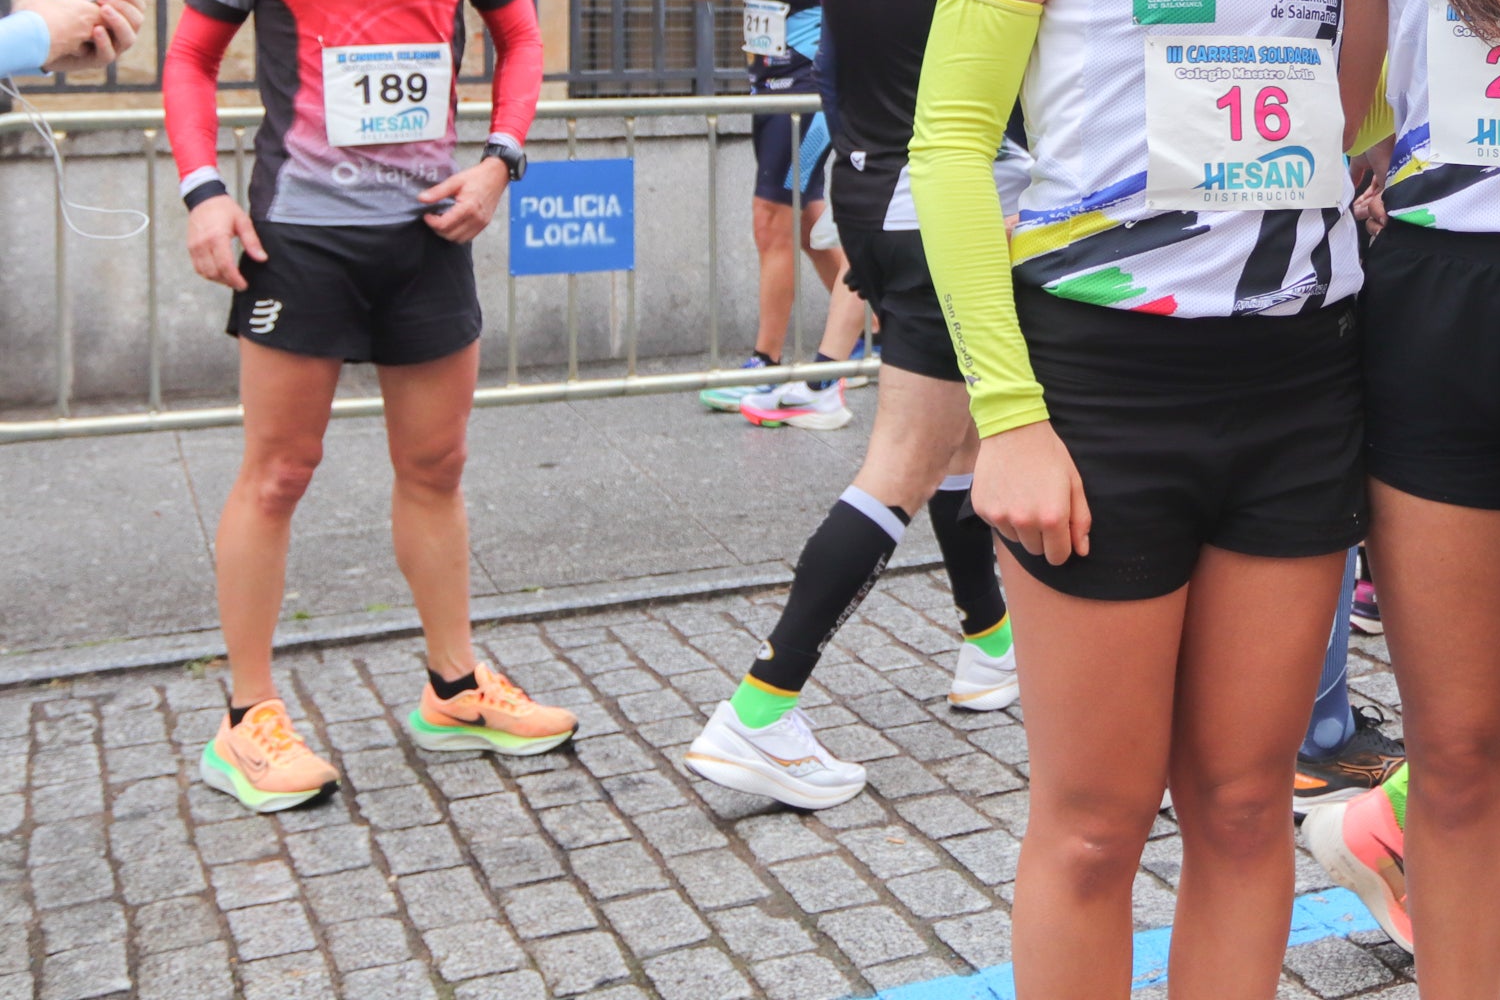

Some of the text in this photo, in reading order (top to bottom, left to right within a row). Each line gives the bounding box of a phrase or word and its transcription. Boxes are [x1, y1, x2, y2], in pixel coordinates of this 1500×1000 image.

[746, 15, 769, 33] 211
[1271, 5, 1336, 25] de Salamanca
[1167, 45, 1322, 66] III CARRERA SOLIDARIA
[1175, 65, 1315, 82] Colegio Maestro Ávila
[354, 73, 428, 104] 189
[359, 115, 424, 133] HESAN
[1216, 86, 1291, 141] 16
[1197, 161, 1305, 190] HESAN
[520, 194, 622, 218] POLICIA
[1204, 190, 1305, 202] DISTRIBUCIÓN
[525, 222, 616, 247] LOCAL
[944, 293, 956, 319] San
